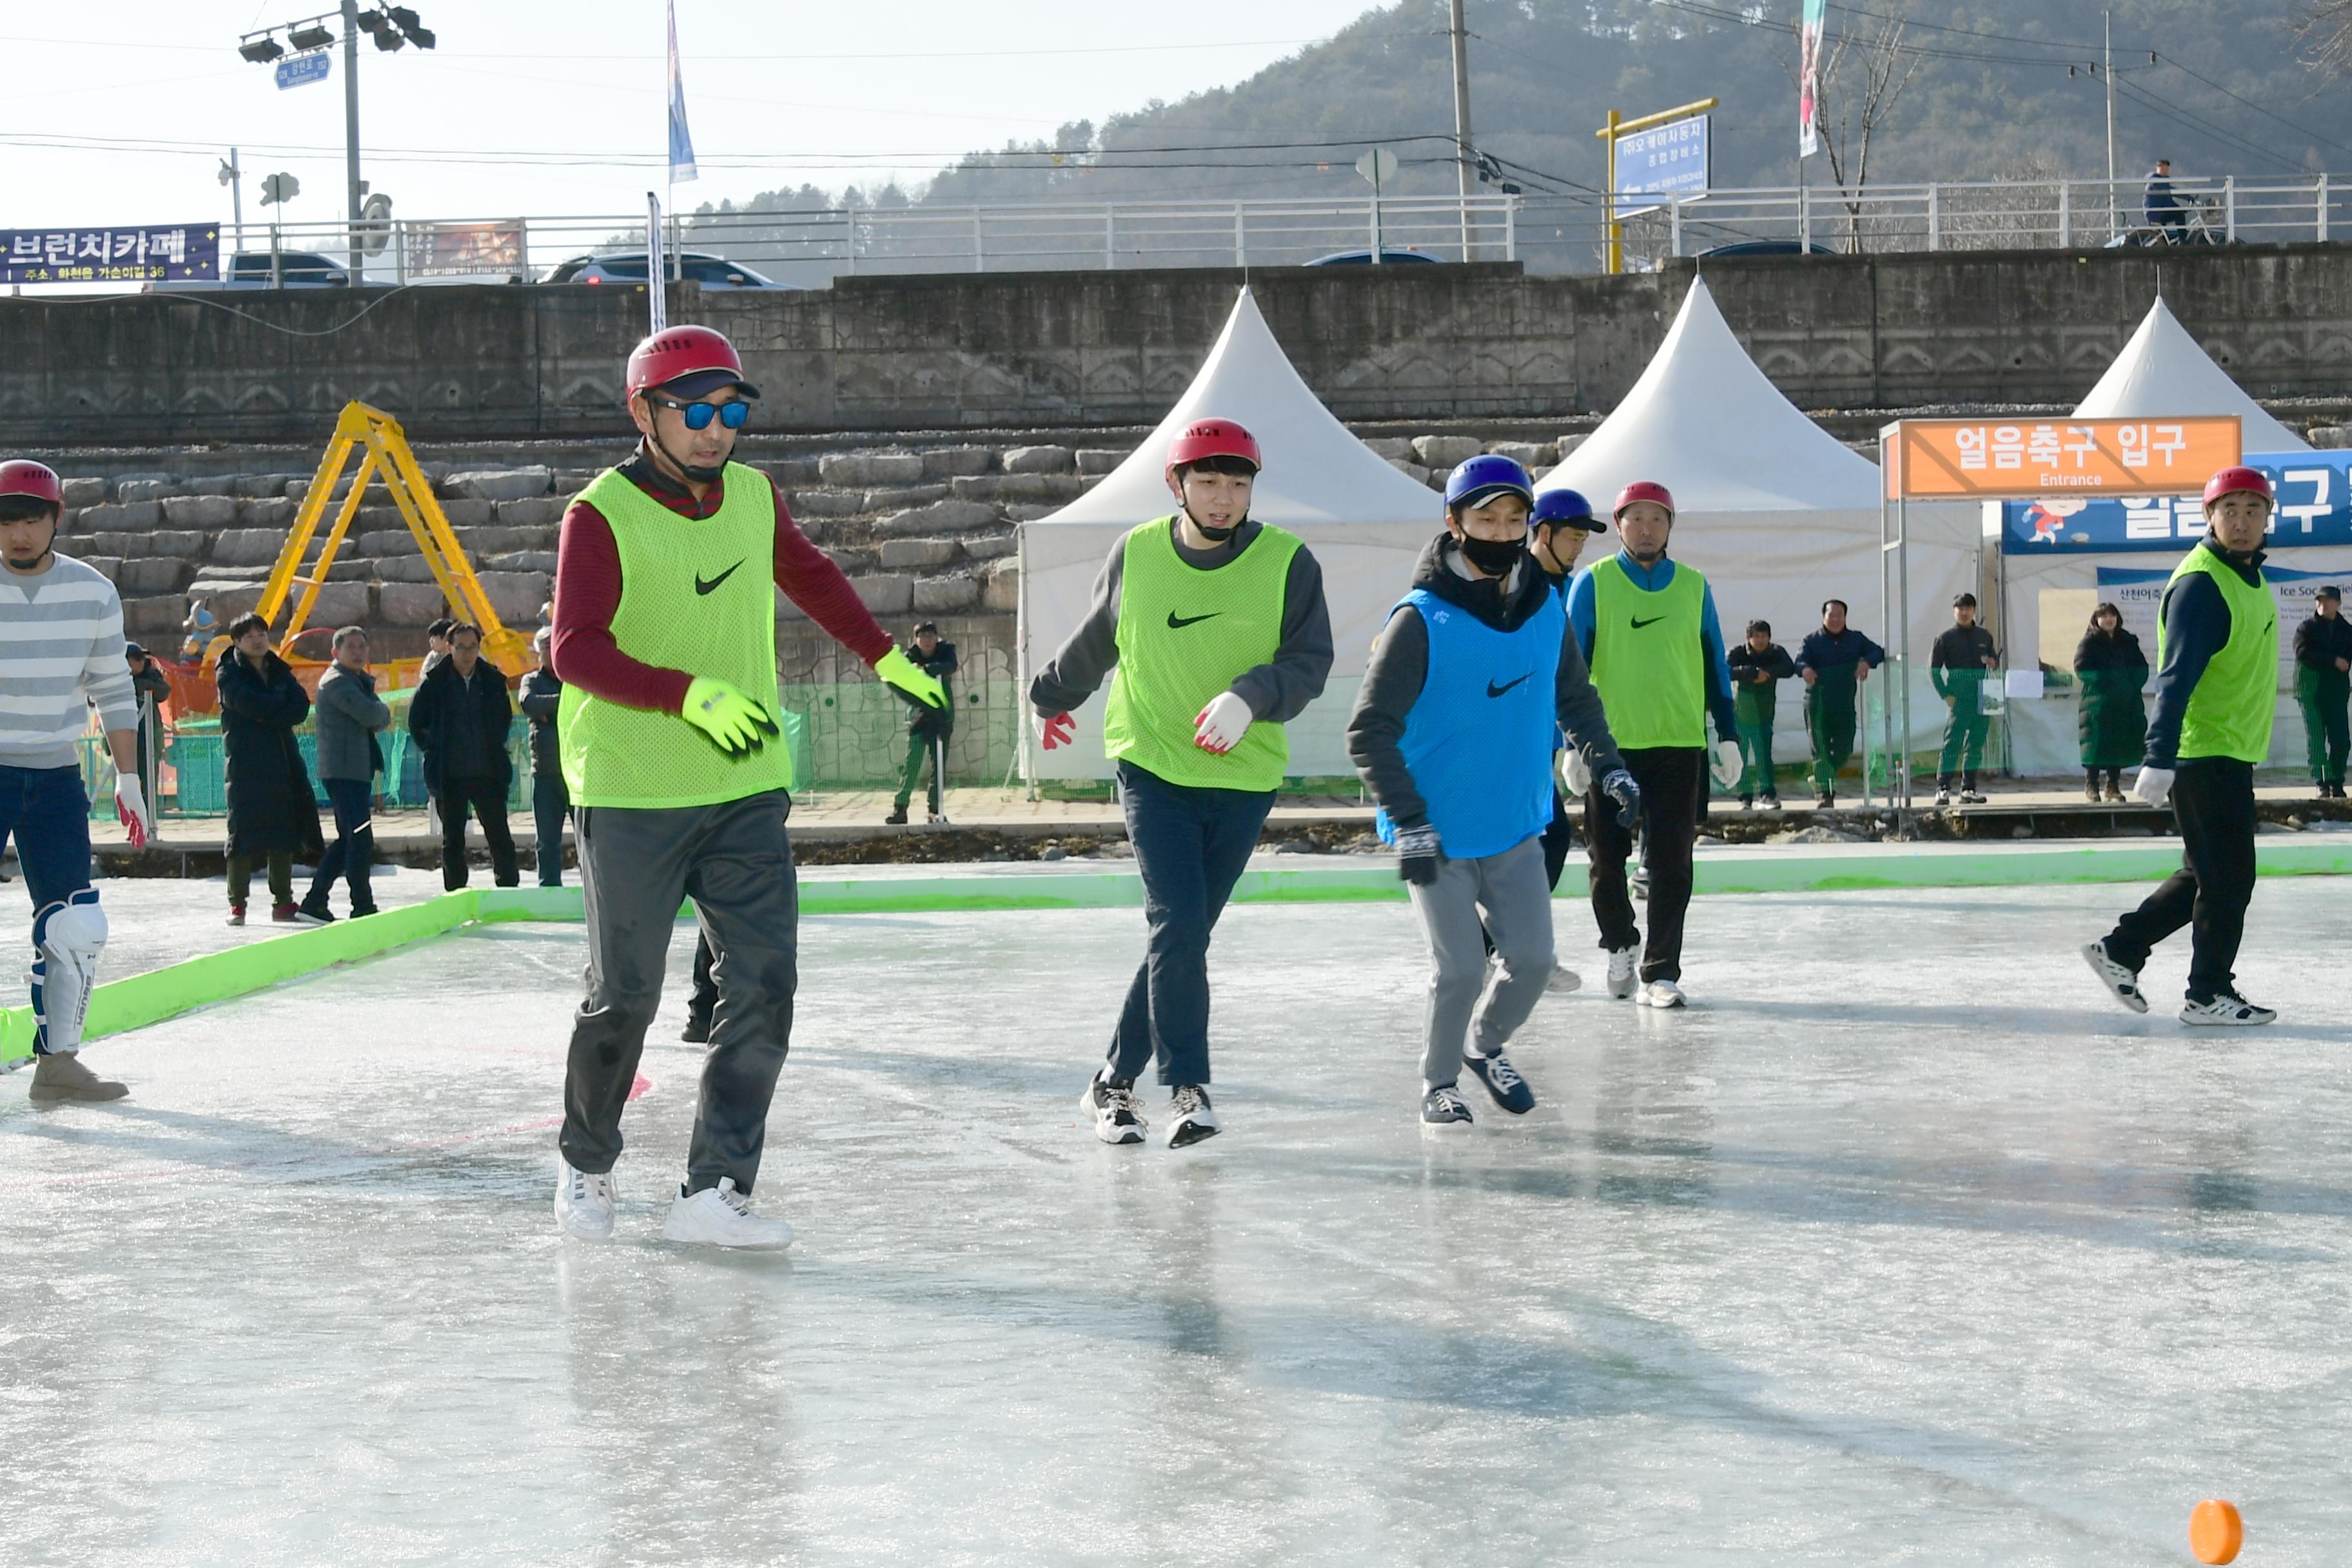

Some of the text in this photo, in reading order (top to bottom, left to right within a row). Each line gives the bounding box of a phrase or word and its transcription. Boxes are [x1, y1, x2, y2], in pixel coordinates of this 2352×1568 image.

[8, 229, 185, 266] 브런치카페
[58, 267, 93, 280] 화천읍
[98, 266, 145, 279] 가손이길
[150, 266, 165, 277] 36
[1955, 424, 2186, 469] 얼음축구 입구
[2040, 473, 2102, 486] Entrance
[2120, 589, 2164, 600] 산천어축
[2280, 586, 2295, 596] Ice
